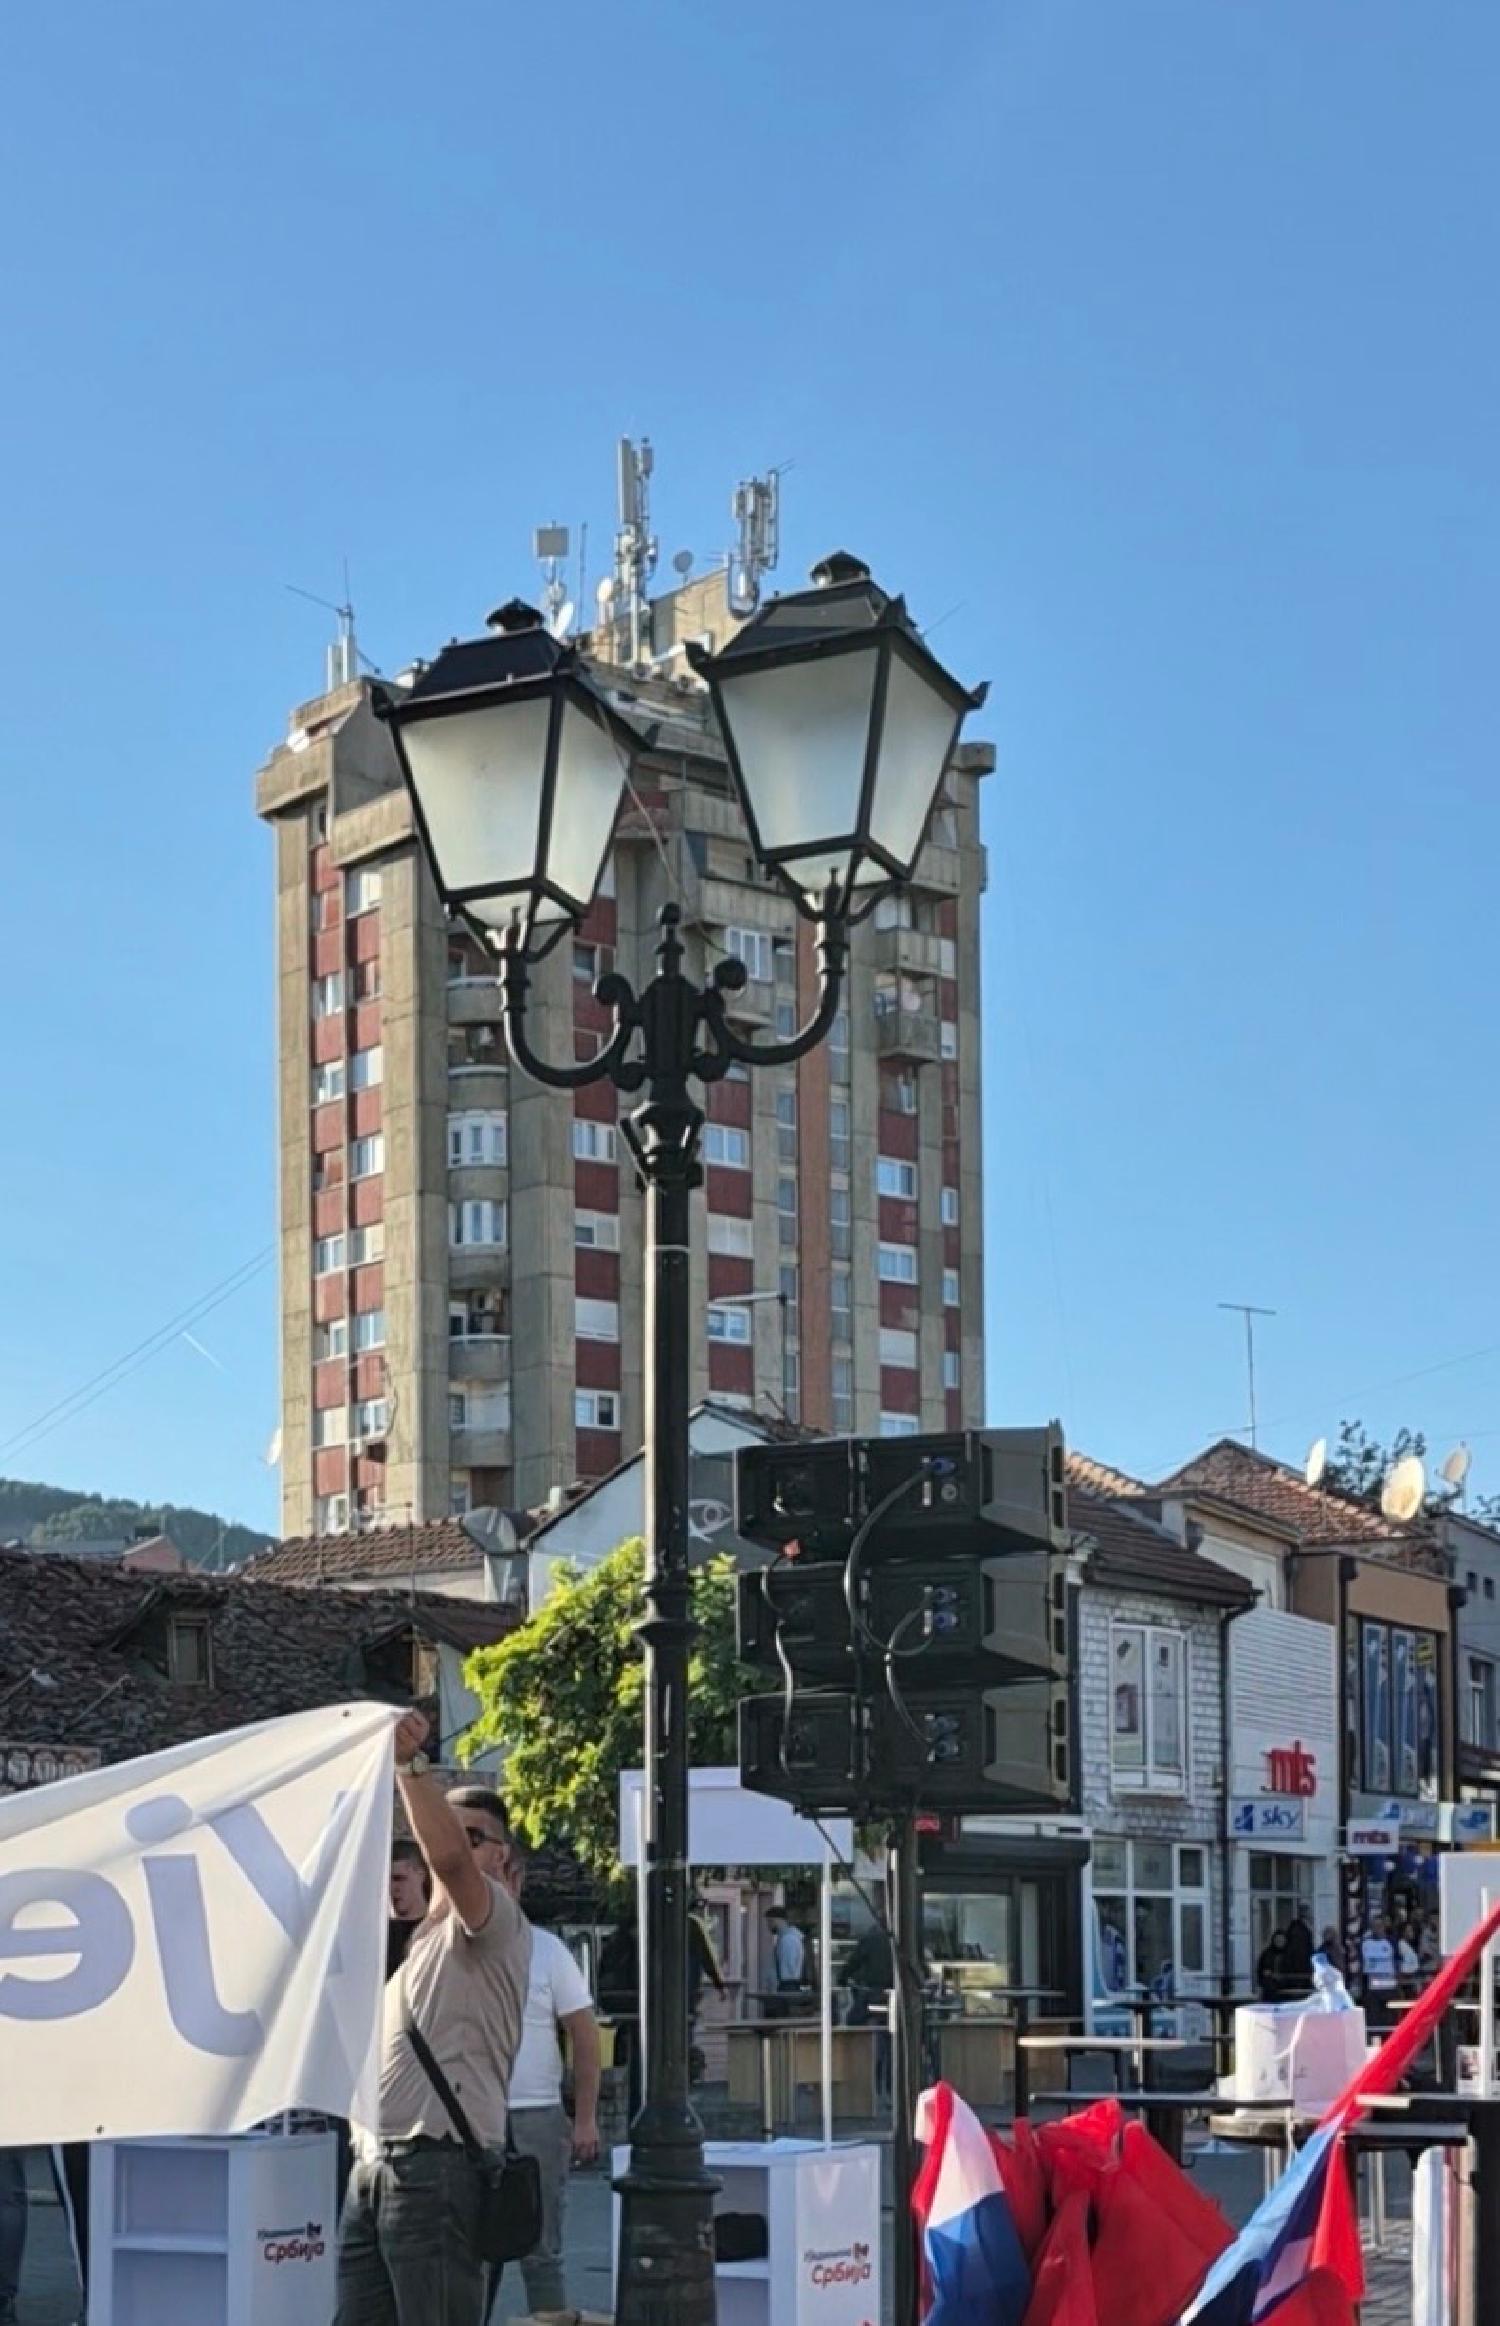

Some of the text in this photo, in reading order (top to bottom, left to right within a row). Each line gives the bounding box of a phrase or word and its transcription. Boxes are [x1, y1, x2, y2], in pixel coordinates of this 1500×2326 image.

[1261, 1740, 1316, 1797] mts
[1262, 1804, 1299, 1830] sky
[264, 2239, 325, 2264] Србија
[812, 2262, 871, 2288] Србија
